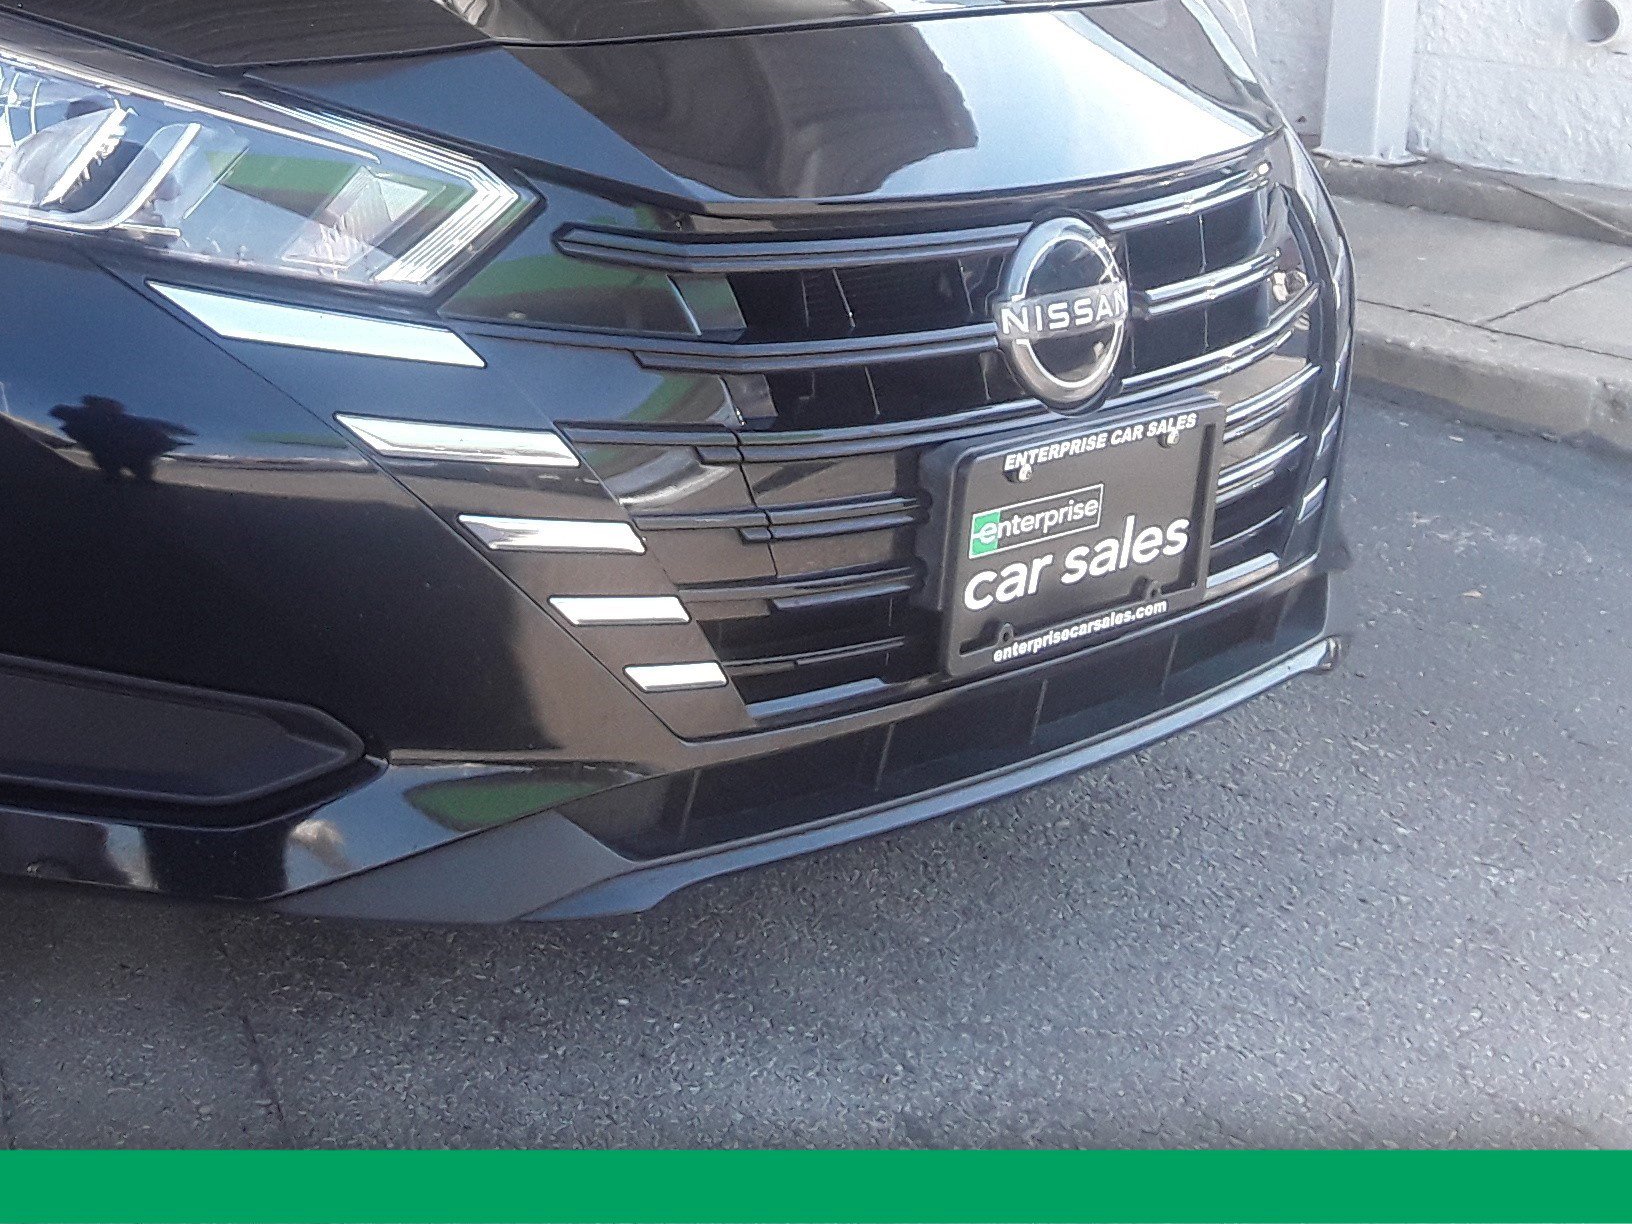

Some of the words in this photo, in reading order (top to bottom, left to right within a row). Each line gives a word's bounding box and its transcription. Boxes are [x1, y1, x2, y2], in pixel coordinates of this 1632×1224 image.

[1001, 289, 1128, 335] NISSAN
[1004, 433, 1108, 471] ENTERPRISE
[1111, 425, 1144, 445] CAR
[1146, 413, 1197, 437] SALES
[976, 497, 1098, 544] enterprise
[964, 553, 1053, 610] car
[1061, 515, 1190, 584] sales
[993, 600, 1167, 662] enterprisecarsales.com
